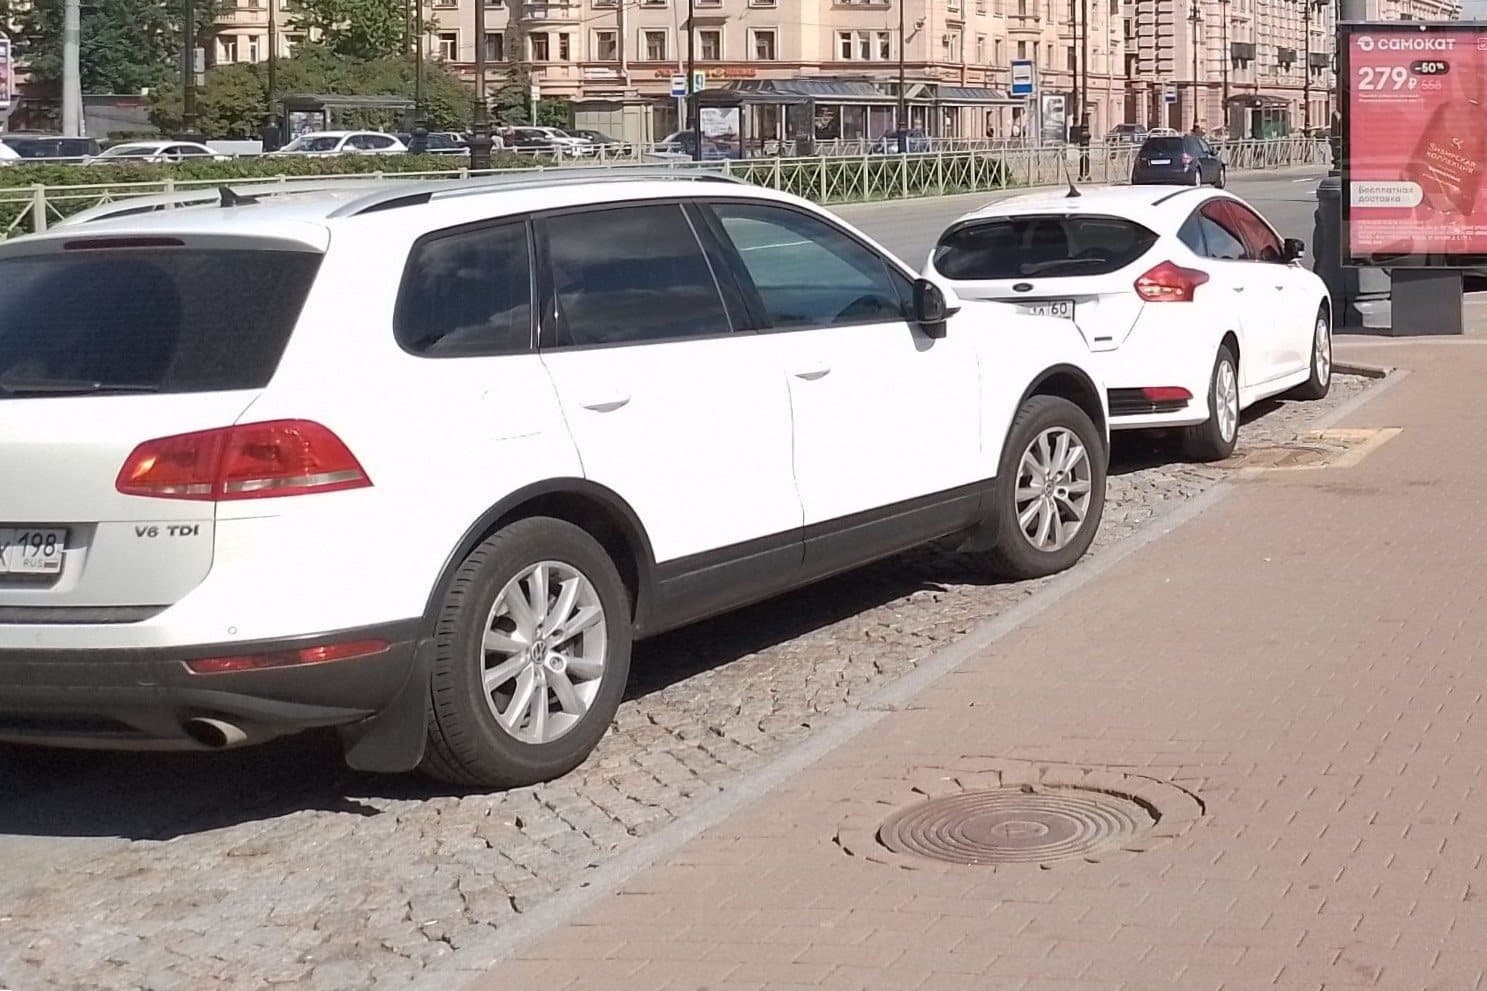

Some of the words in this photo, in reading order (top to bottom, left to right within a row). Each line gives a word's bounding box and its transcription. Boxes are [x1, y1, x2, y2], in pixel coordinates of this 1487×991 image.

[1378, 38, 1456, 50] самокат
[134, 525, 160, 538] V6
[167, 524, 200, 536] TDI
[17, 532, 57, 557] 198
